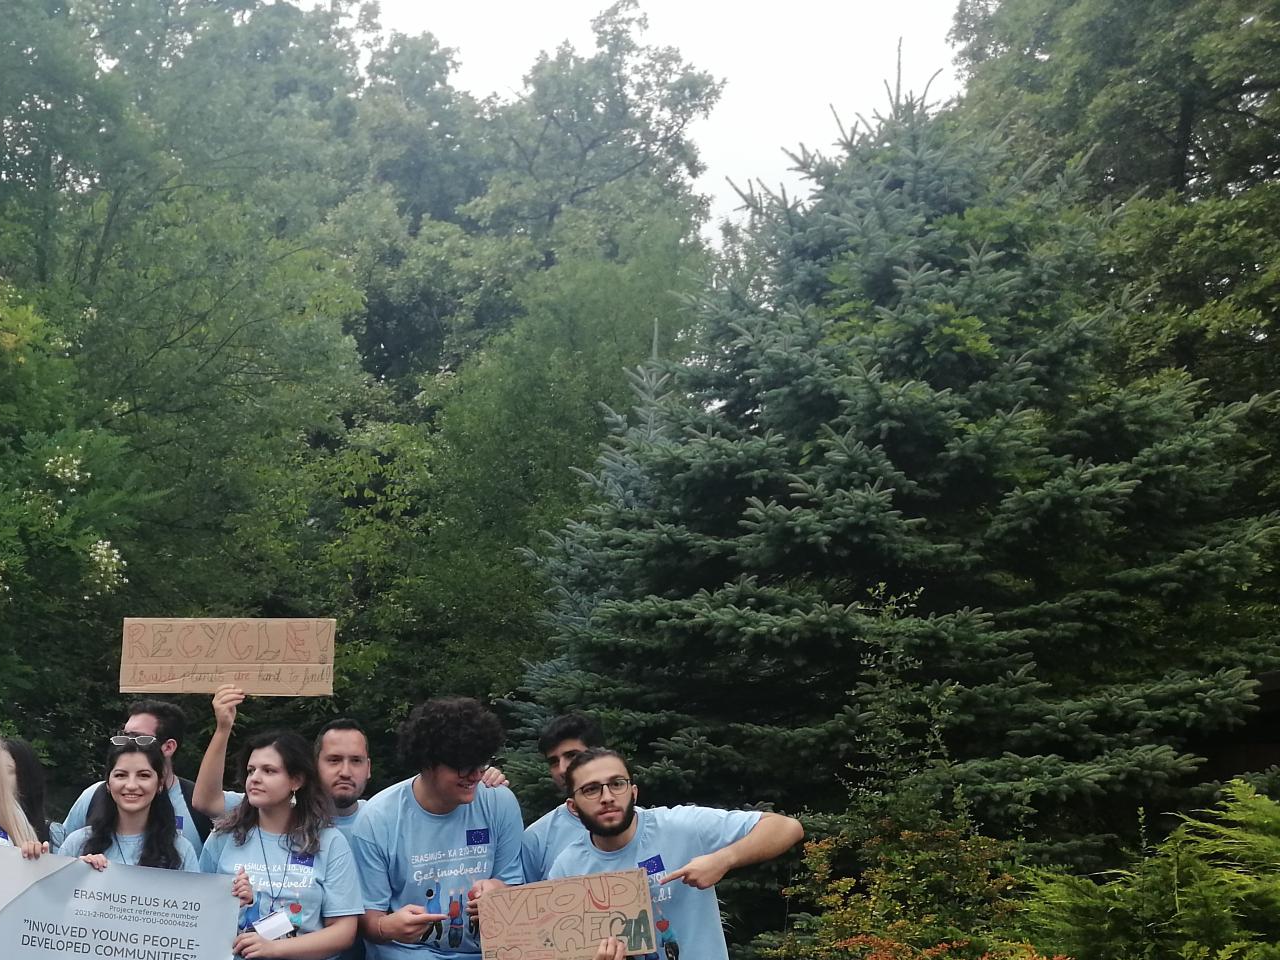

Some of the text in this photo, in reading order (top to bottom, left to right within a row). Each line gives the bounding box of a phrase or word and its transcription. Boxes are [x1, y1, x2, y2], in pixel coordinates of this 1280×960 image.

[73, 889, 201, 912] ERASMUS PLUS KA 210
[109, 905, 200, 921] Project reference number
[21, 934, 92, 955] DEVELOPED
[91, 928, 139, 945] YOUNG
[142, 934, 201, 951] PEOPLE-
